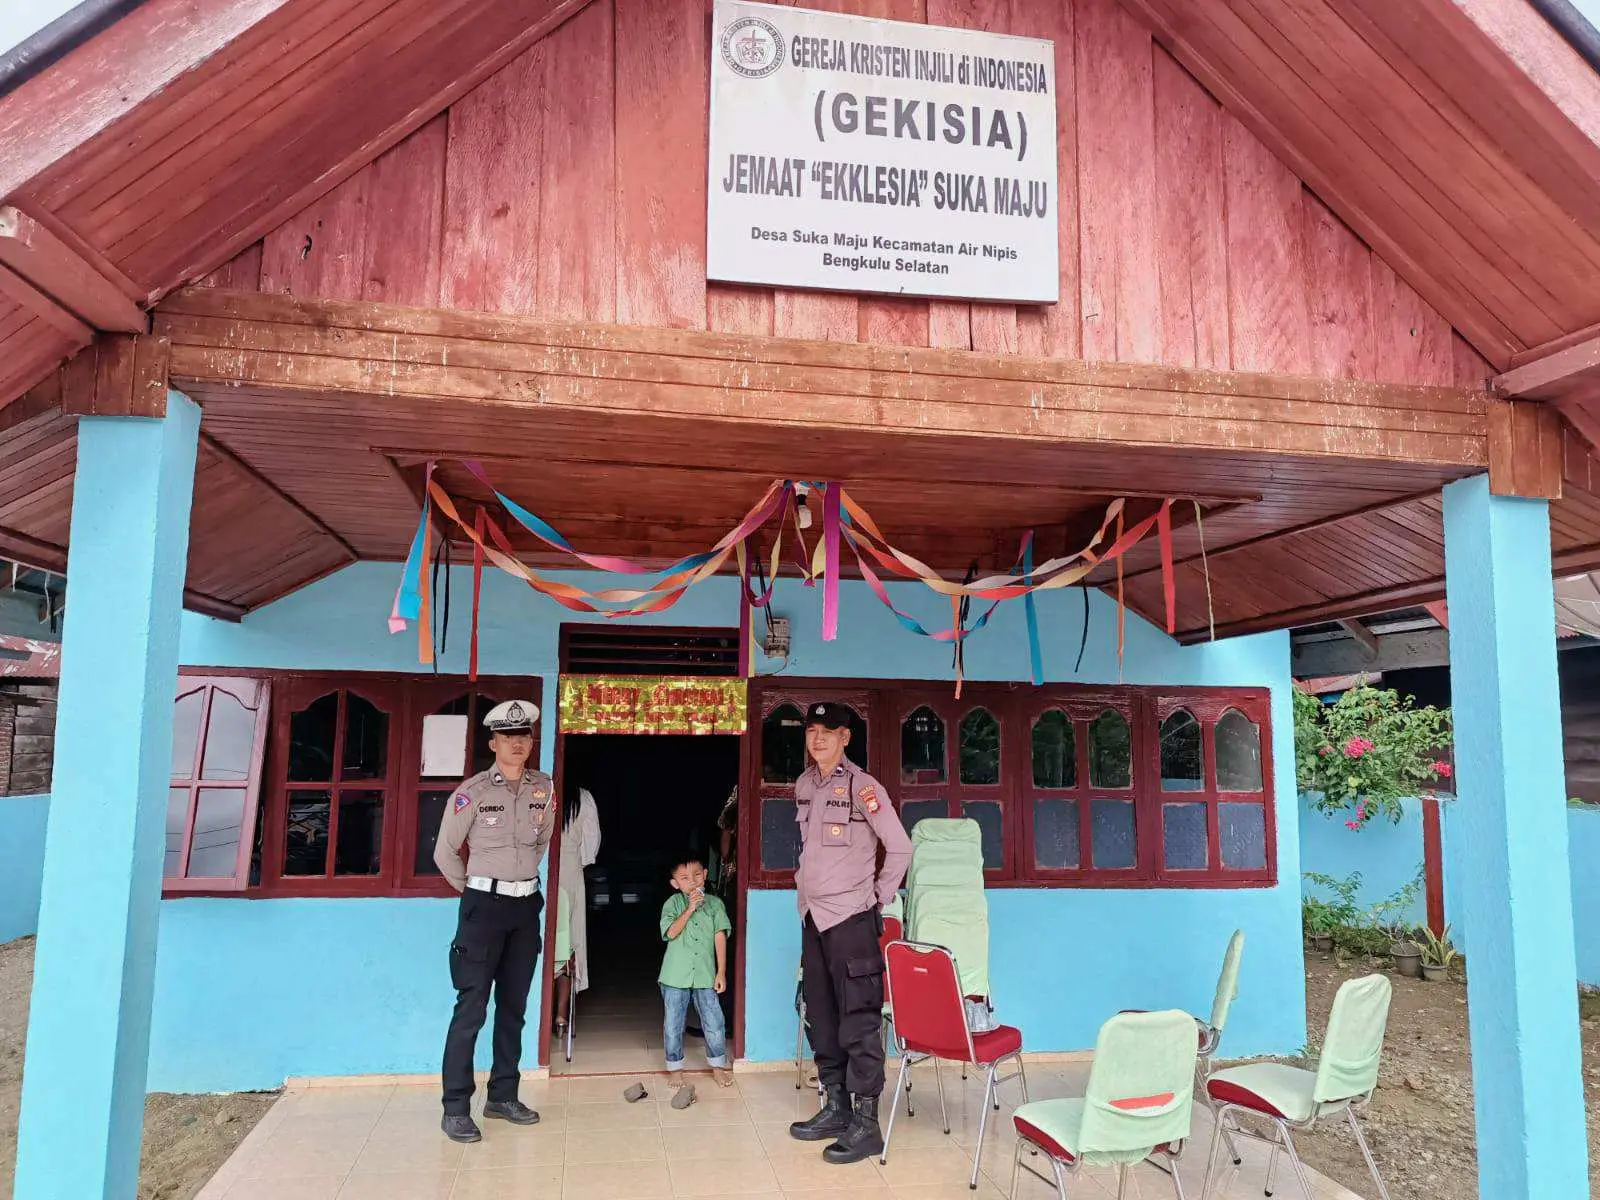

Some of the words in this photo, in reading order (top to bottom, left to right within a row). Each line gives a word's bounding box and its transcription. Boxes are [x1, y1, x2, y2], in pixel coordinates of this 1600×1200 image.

[791, 34, 847, 72] GEREJA
[850, 41, 911, 79] KRISTEN
[914, 49, 954, 84] INJILI
[957, 55, 970, 86] di
[973, 56, 1048, 94] INDONESIA
[814, 90, 1028, 162] (GEKISIA)
[722, 154, 806, 198] JEMAAT
[933, 171, 988, 214] SUKA
[994, 177, 1047, 219] MAJU
[751, 226, 788, 242] Desa
[792, 229, 829, 245] Suka
[833, 232, 868, 251] Maju
[872, 235, 954, 255] Kecamatan
[957, 242, 979, 257] Air
[982, 244, 1018, 262] Nipis
[822, 252, 891, 272] Bengkulu
[894, 257, 949, 275] Selatan
